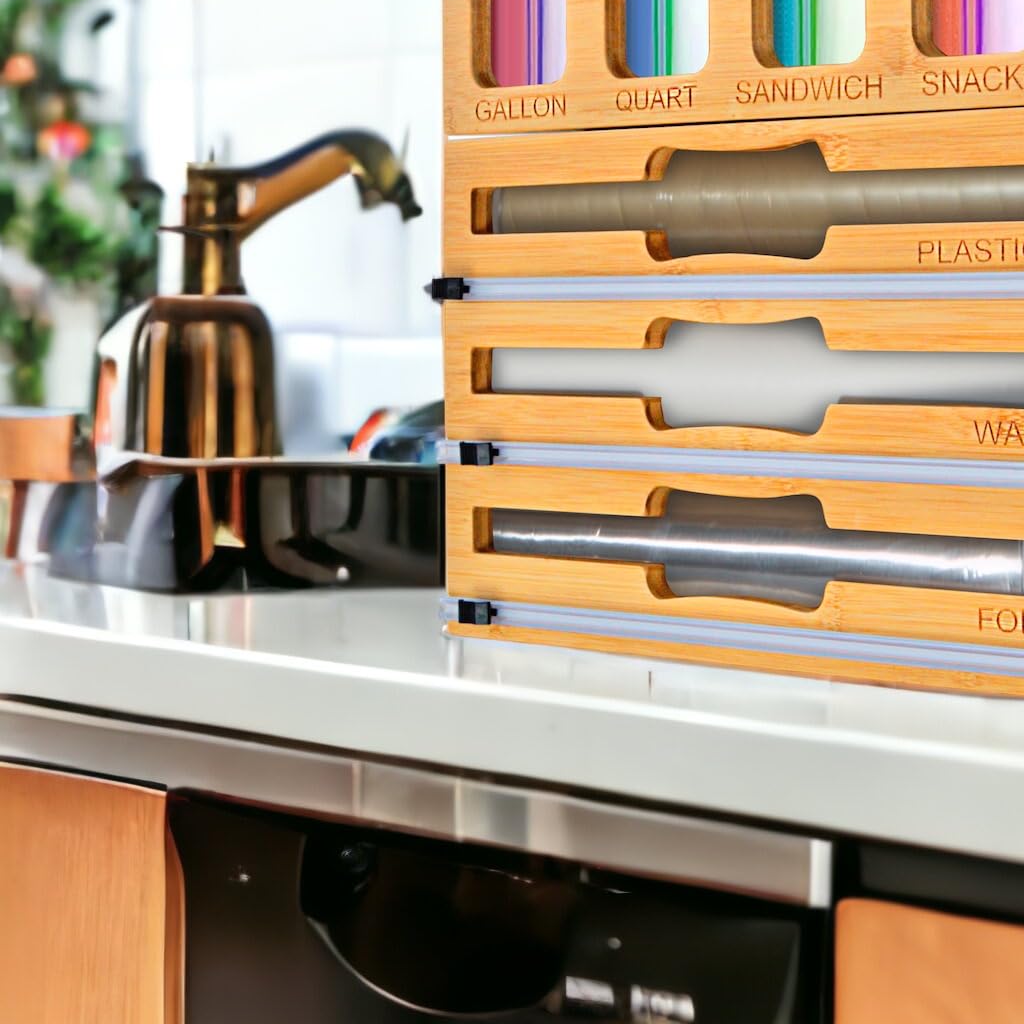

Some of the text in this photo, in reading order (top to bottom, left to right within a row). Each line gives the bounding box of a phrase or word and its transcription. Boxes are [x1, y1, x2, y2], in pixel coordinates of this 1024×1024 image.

[735, 74, 883, 104] SANDWICH
[922, 64, 1024, 97] SNACK
[475, 95, 567, 122] GALLON
[616, 85, 698, 113] QUART
